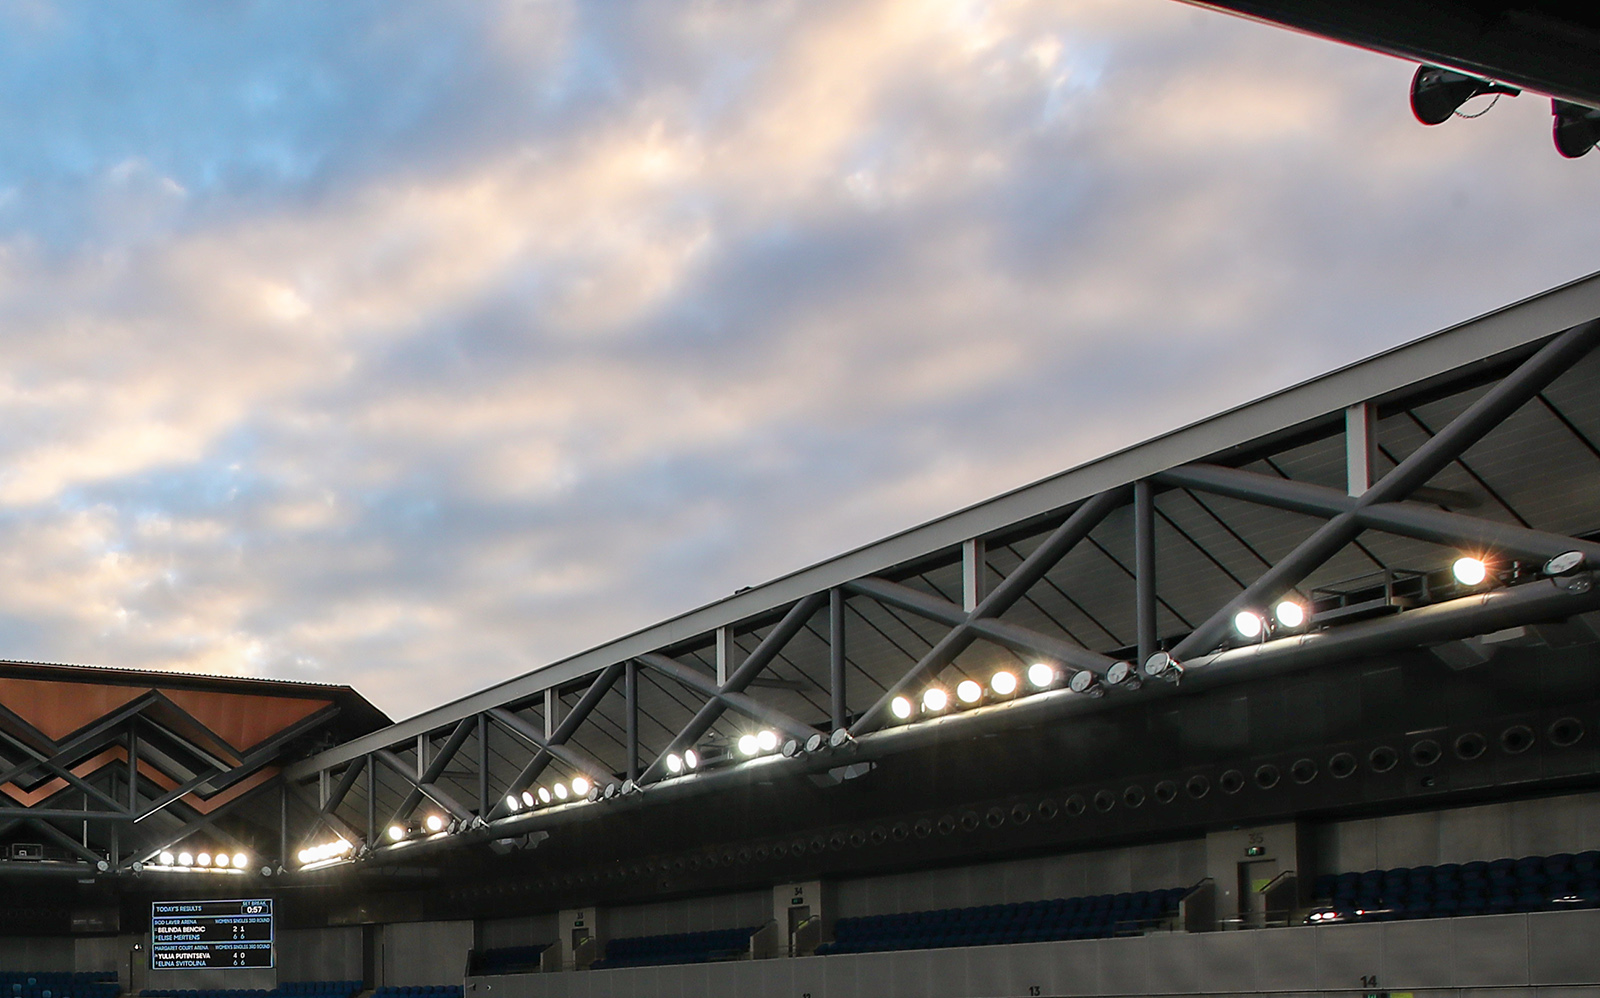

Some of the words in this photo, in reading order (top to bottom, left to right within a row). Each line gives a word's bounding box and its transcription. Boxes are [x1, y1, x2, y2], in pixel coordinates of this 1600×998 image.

[247, 906, 262, 914] 0:57
[1360, 975, 1377, 988] 14
[1029, 986, 1041, 997] 13
